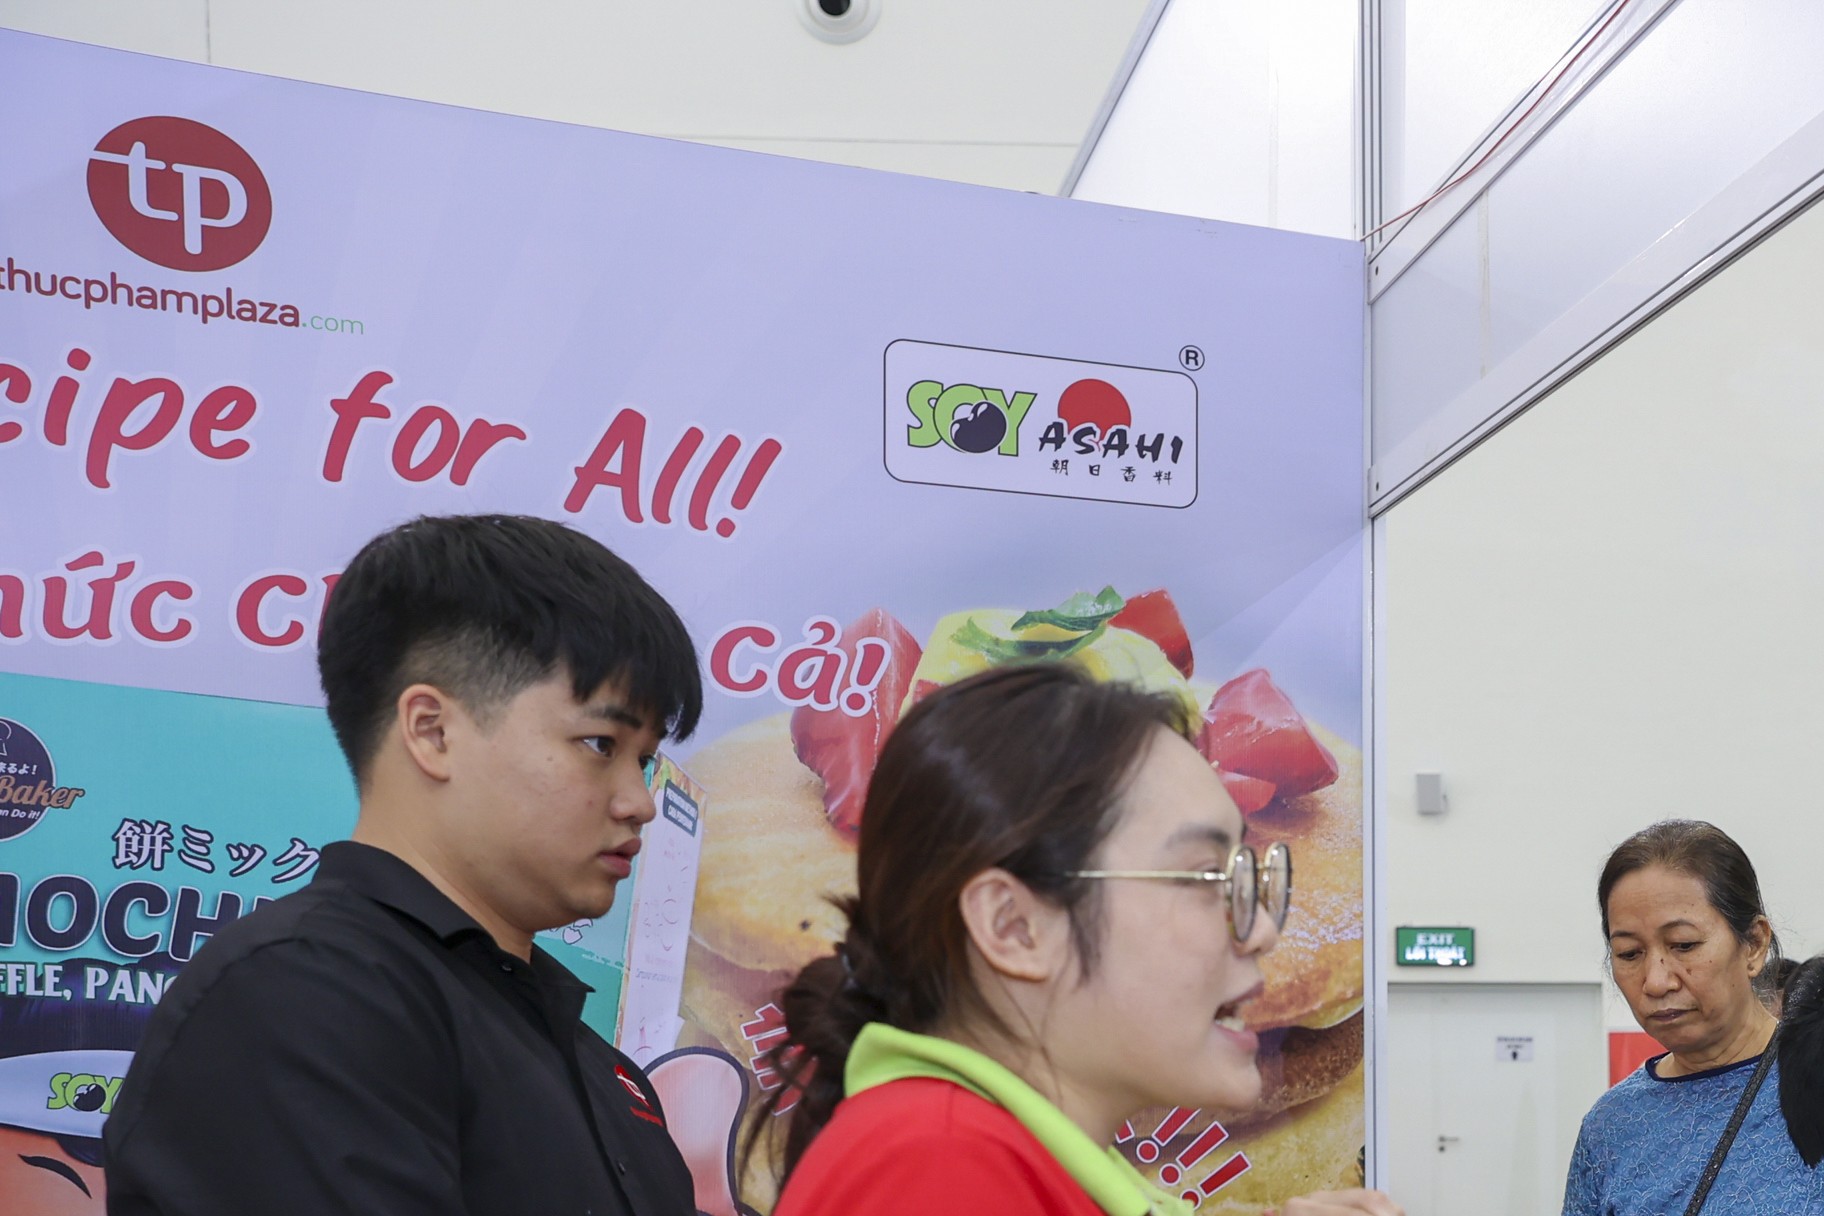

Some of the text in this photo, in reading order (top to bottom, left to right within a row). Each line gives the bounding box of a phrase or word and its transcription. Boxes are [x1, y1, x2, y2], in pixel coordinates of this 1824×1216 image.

[93, 141, 248, 255] tp
[323, 371, 526, 487] for
[564, 408, 782, 538] All!
[906, 379, 1038, 457] SOY
[1038, 421, 1183, 464] ASAHI
[710, 619, 890, 716] cả!
[1416, 932, 1455, 946] EXIT
